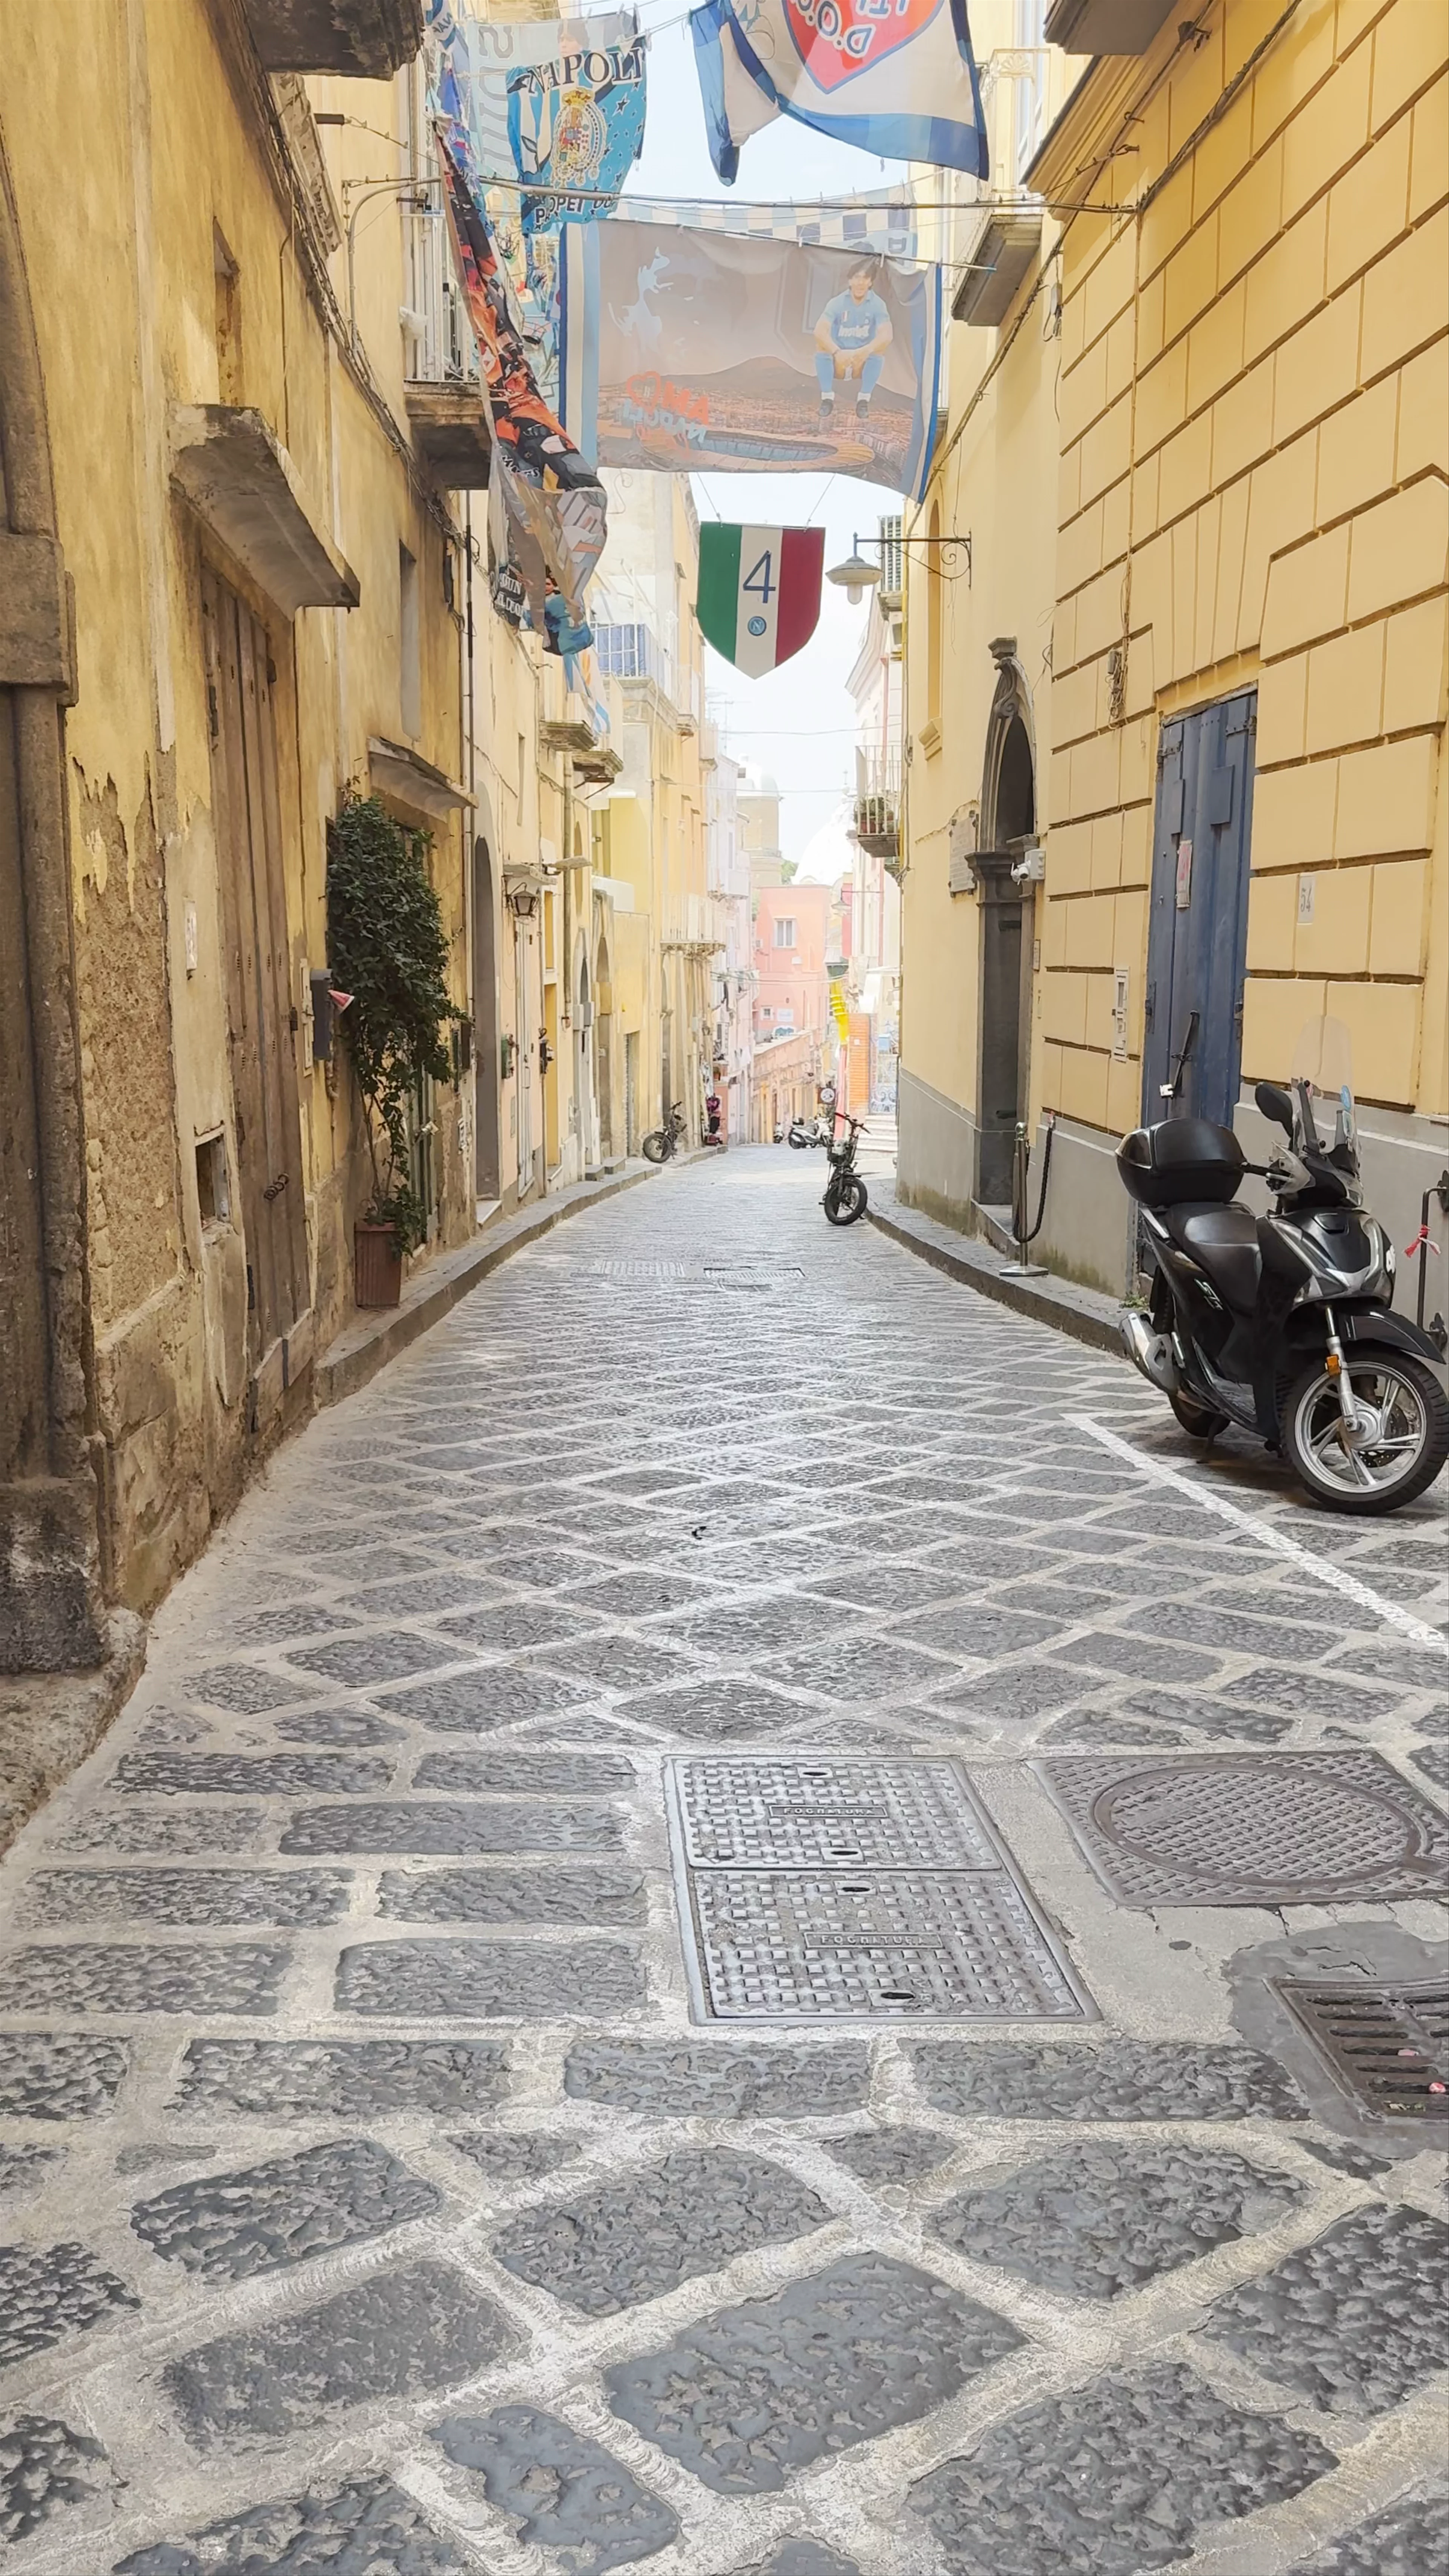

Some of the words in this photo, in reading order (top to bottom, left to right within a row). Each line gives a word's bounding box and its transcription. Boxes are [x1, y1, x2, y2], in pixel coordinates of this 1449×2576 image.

[528, 48, 642, 94] NAPOLI
[743, 550, 776, 603] 4
[1300, 883, 1312, 912] 54
